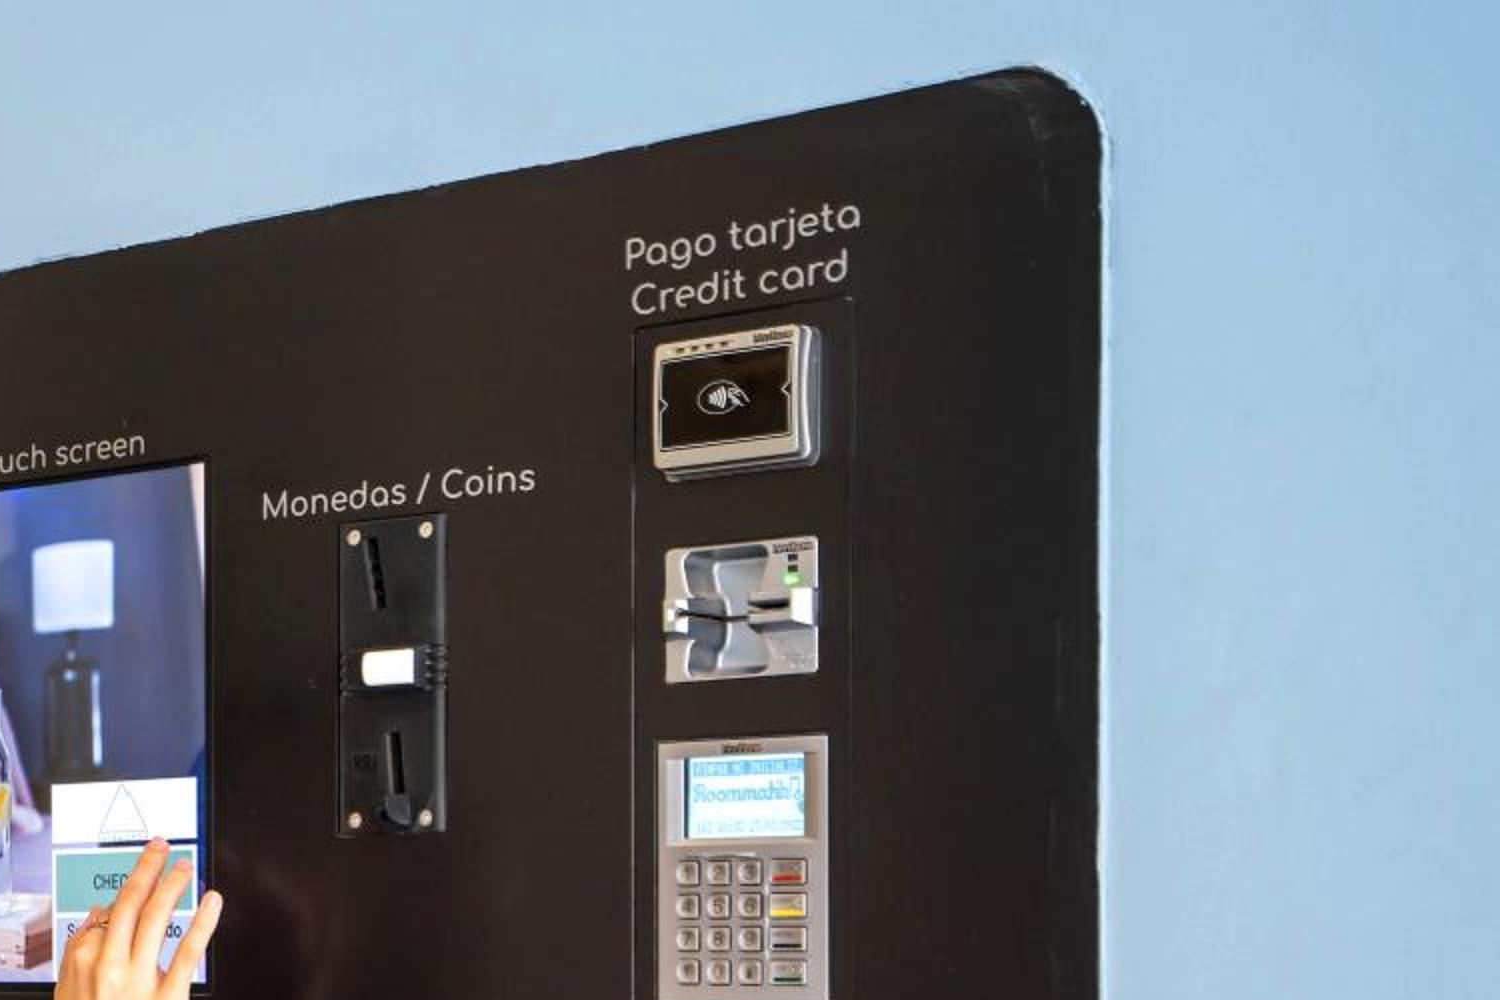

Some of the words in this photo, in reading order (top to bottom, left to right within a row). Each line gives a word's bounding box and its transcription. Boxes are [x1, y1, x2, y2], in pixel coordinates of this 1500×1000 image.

[625, 233, 717, 270] Pago
[729, 203, 861, 251] tarjeta
[631, 269, 747, 315] Credit
[758, 248, 849, 294] card
[55, 434, 145, 466] screen
[262, 480, 407, 521] Monedas
[416, 472, 431, 505] /
[441, 465, 536, 499] Coins
[93, 873, 129, 890] CHEC
